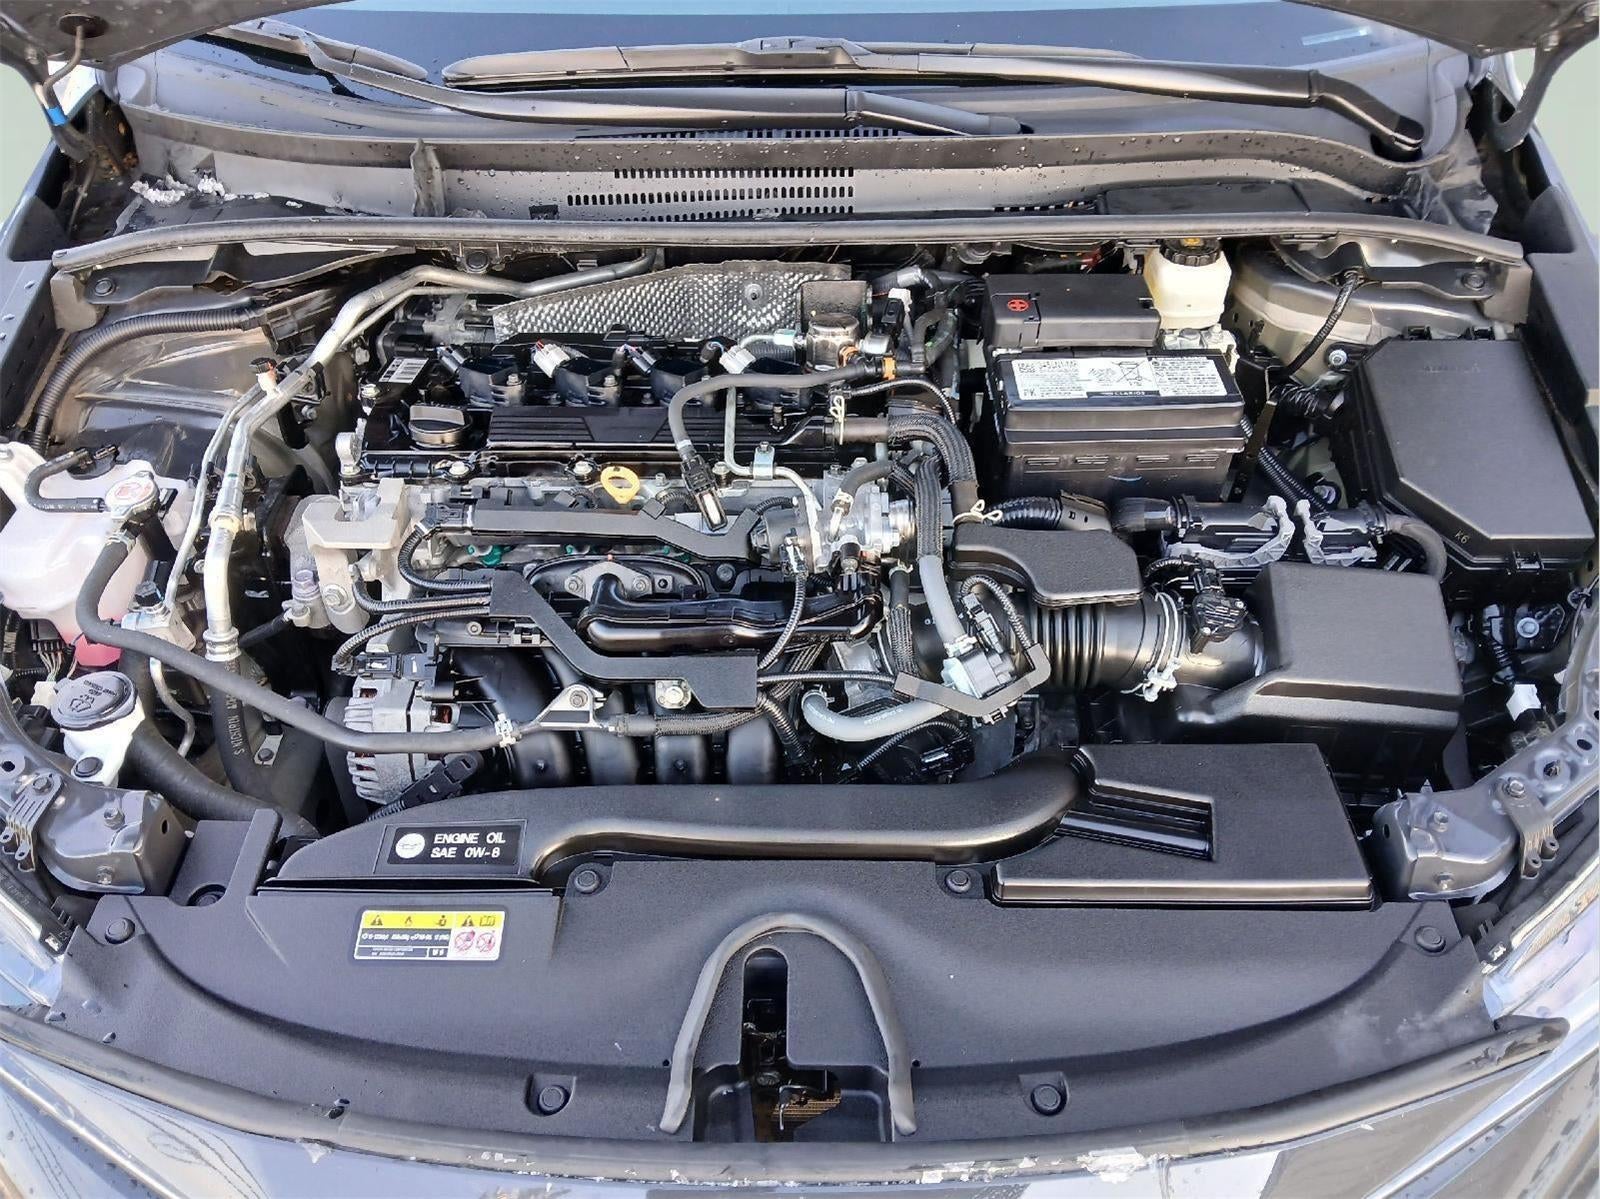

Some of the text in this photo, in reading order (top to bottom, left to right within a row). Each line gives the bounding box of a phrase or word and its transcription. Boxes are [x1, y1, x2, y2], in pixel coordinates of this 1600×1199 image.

[433, 832, 506, 844] ENGINE OIL
[430, 846, 501, 859] SAE 0W-8
